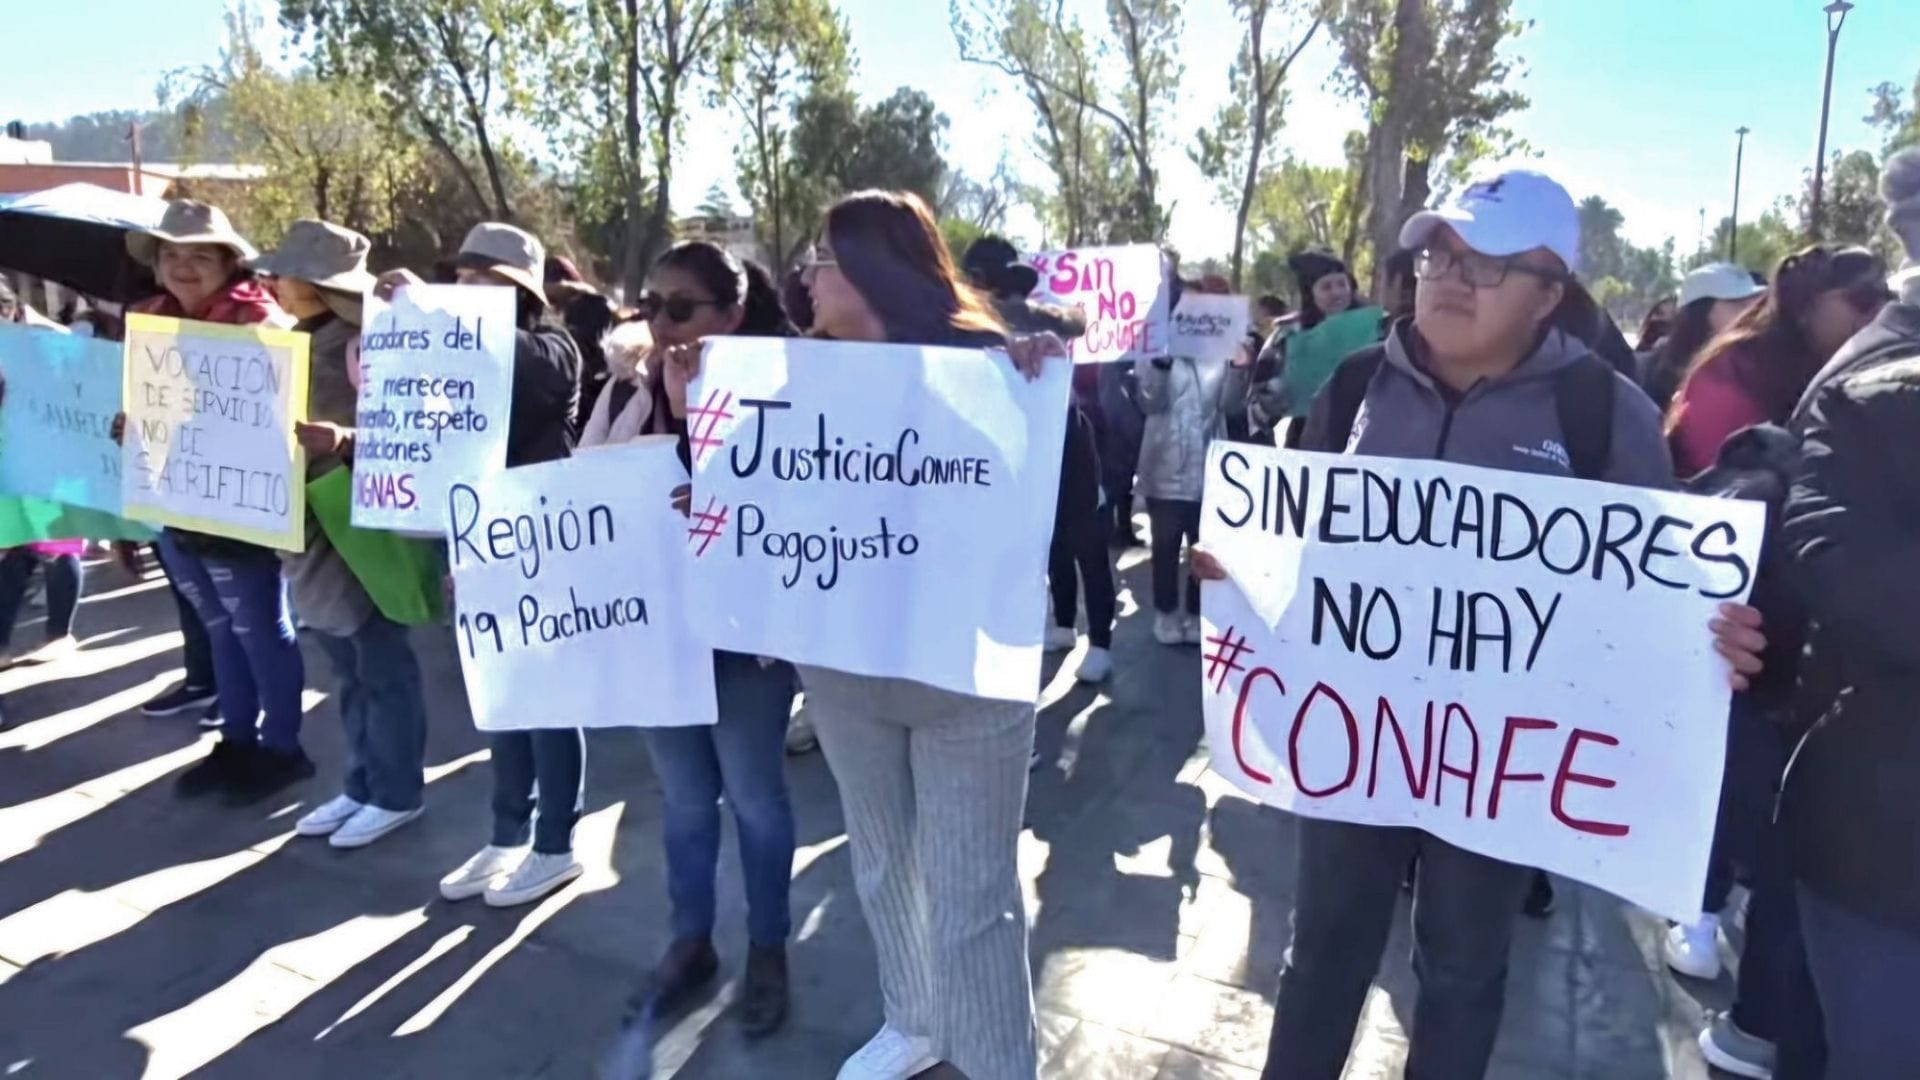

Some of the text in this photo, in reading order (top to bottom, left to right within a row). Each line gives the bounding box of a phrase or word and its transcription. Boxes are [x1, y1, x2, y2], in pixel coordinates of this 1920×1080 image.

[1098, 291, 1136, 320] NO
[442, 315, 482, 351] del
[145, 344, 282, 395] VOCACIÓN
[383, 375, 475, 400] merecen
[143, 382, 170, 408] DE
[142, 419, 169, 444] NO
[403, 403, 488, 443] respeto
[450, 483, 614, 580] Región
[1216, 451, 1750, 599] SIN EDUCADORES
[458, 586, 649, 659] 19 Pachuca
[1311, 576, 1562, 674] NO HAY
[1203, 624, 1631, 837] #CONAFE
